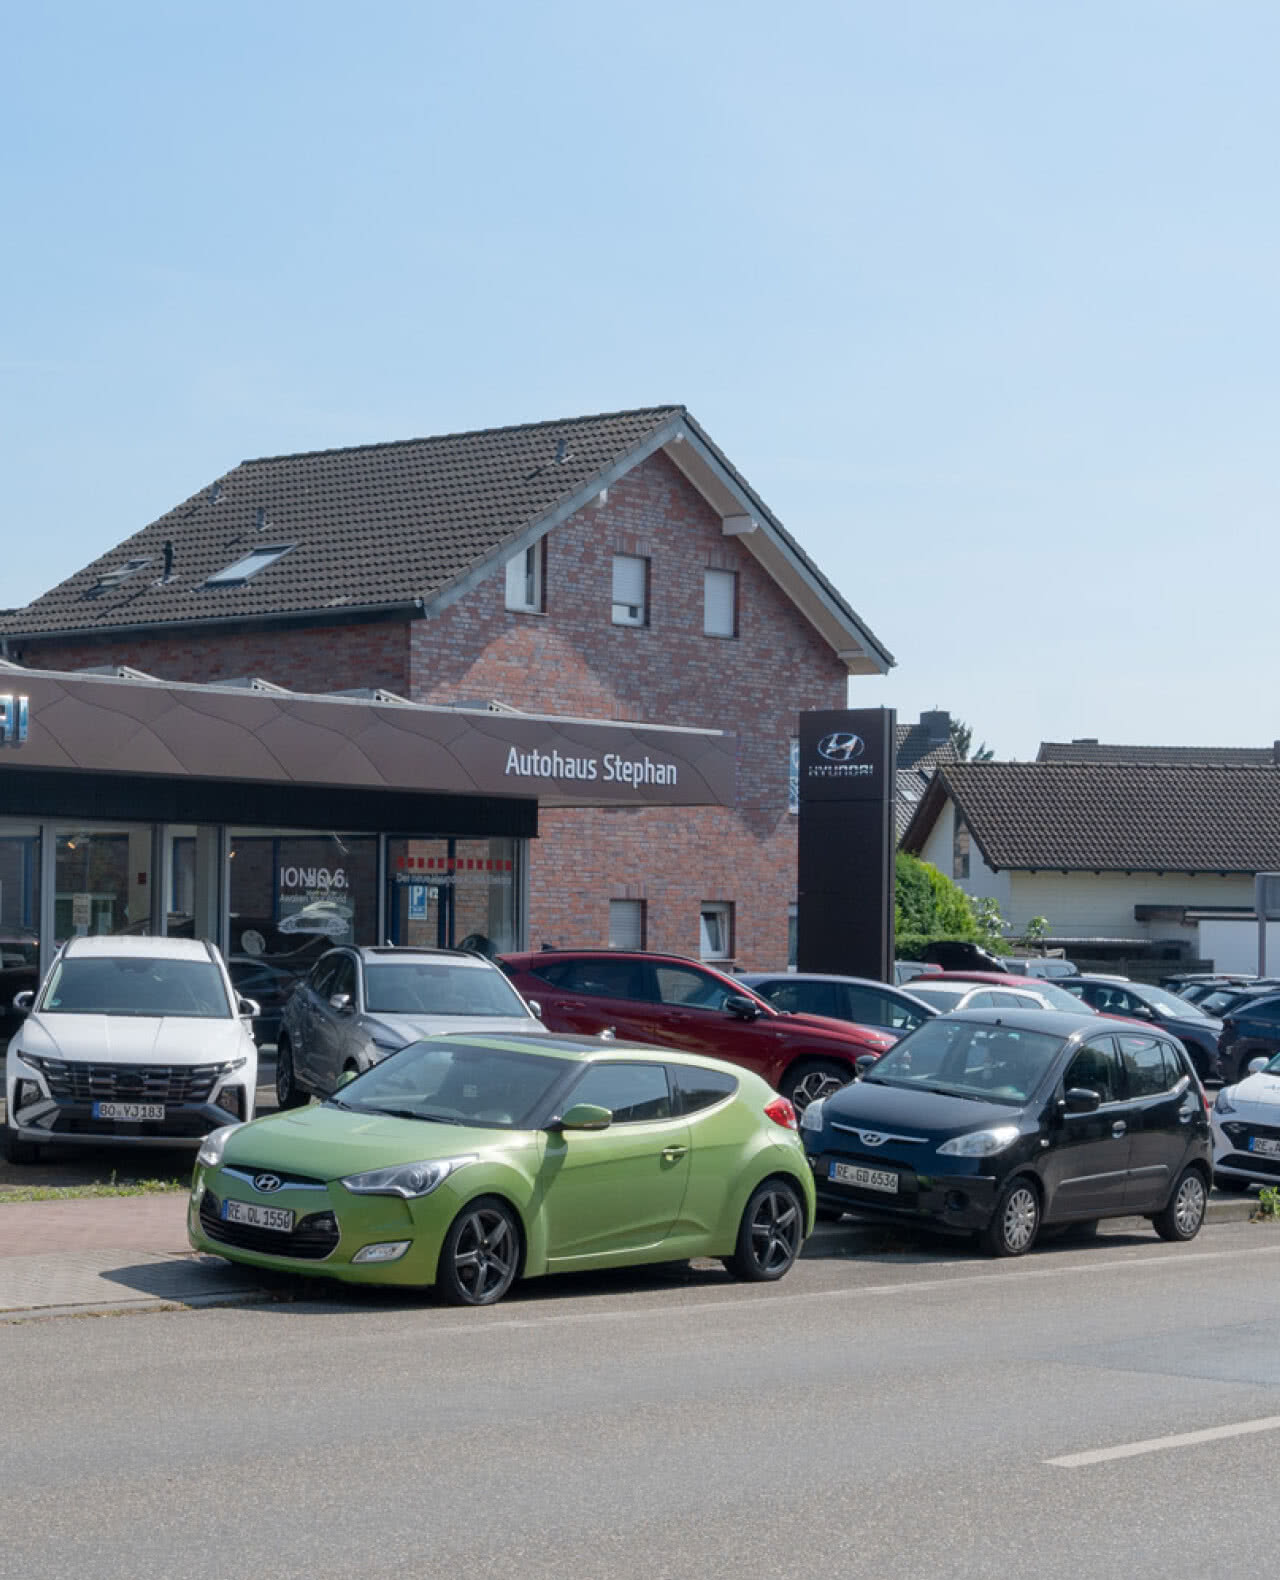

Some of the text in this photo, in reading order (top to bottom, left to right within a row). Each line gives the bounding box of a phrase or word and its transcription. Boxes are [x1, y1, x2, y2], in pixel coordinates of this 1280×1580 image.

[505, 747, 677, 789] Autohaus Stephan
[809, 764, 873, 777] HYUNDAI
